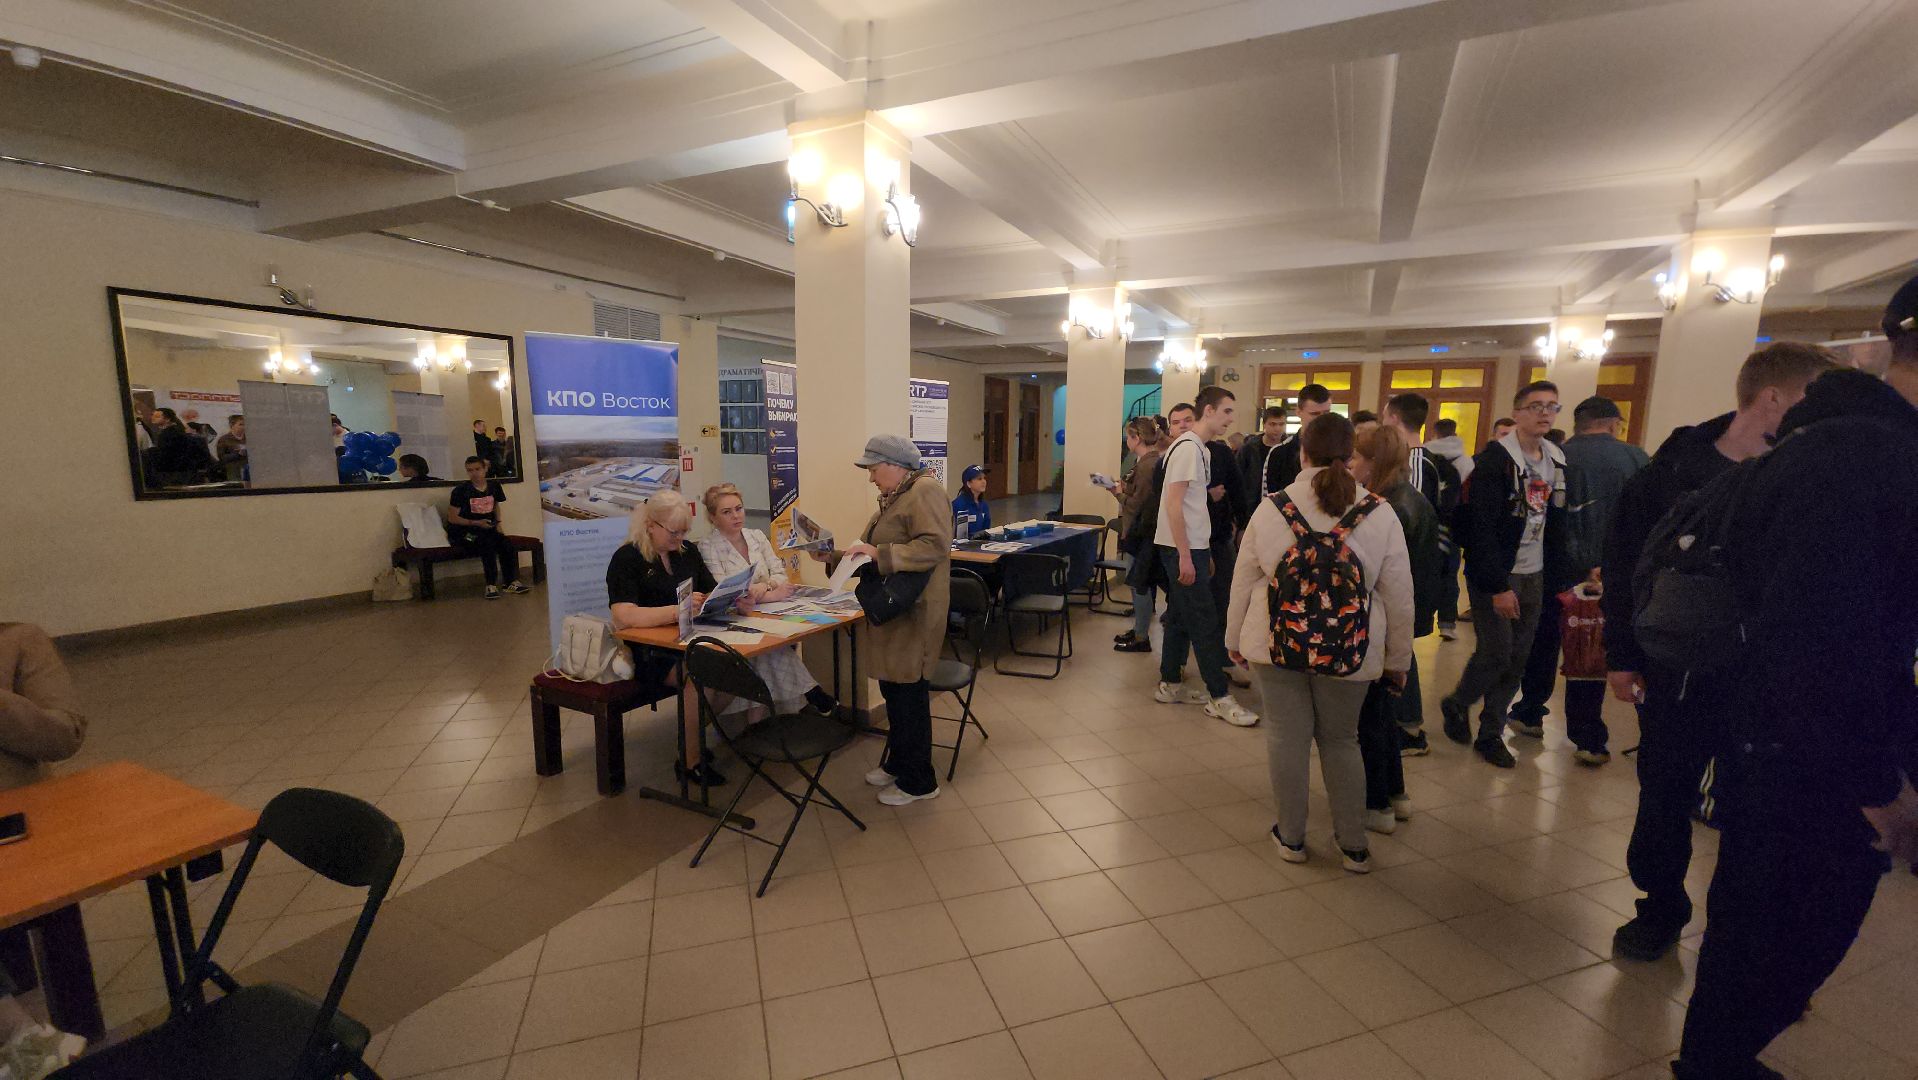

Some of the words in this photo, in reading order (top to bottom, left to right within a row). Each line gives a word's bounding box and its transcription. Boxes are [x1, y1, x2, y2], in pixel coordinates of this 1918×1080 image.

[547, 390, 596, 408] КПО
[602, 392, 671, 409] Восток
[767, 398, 794, 410] ПОЧЕМУ
